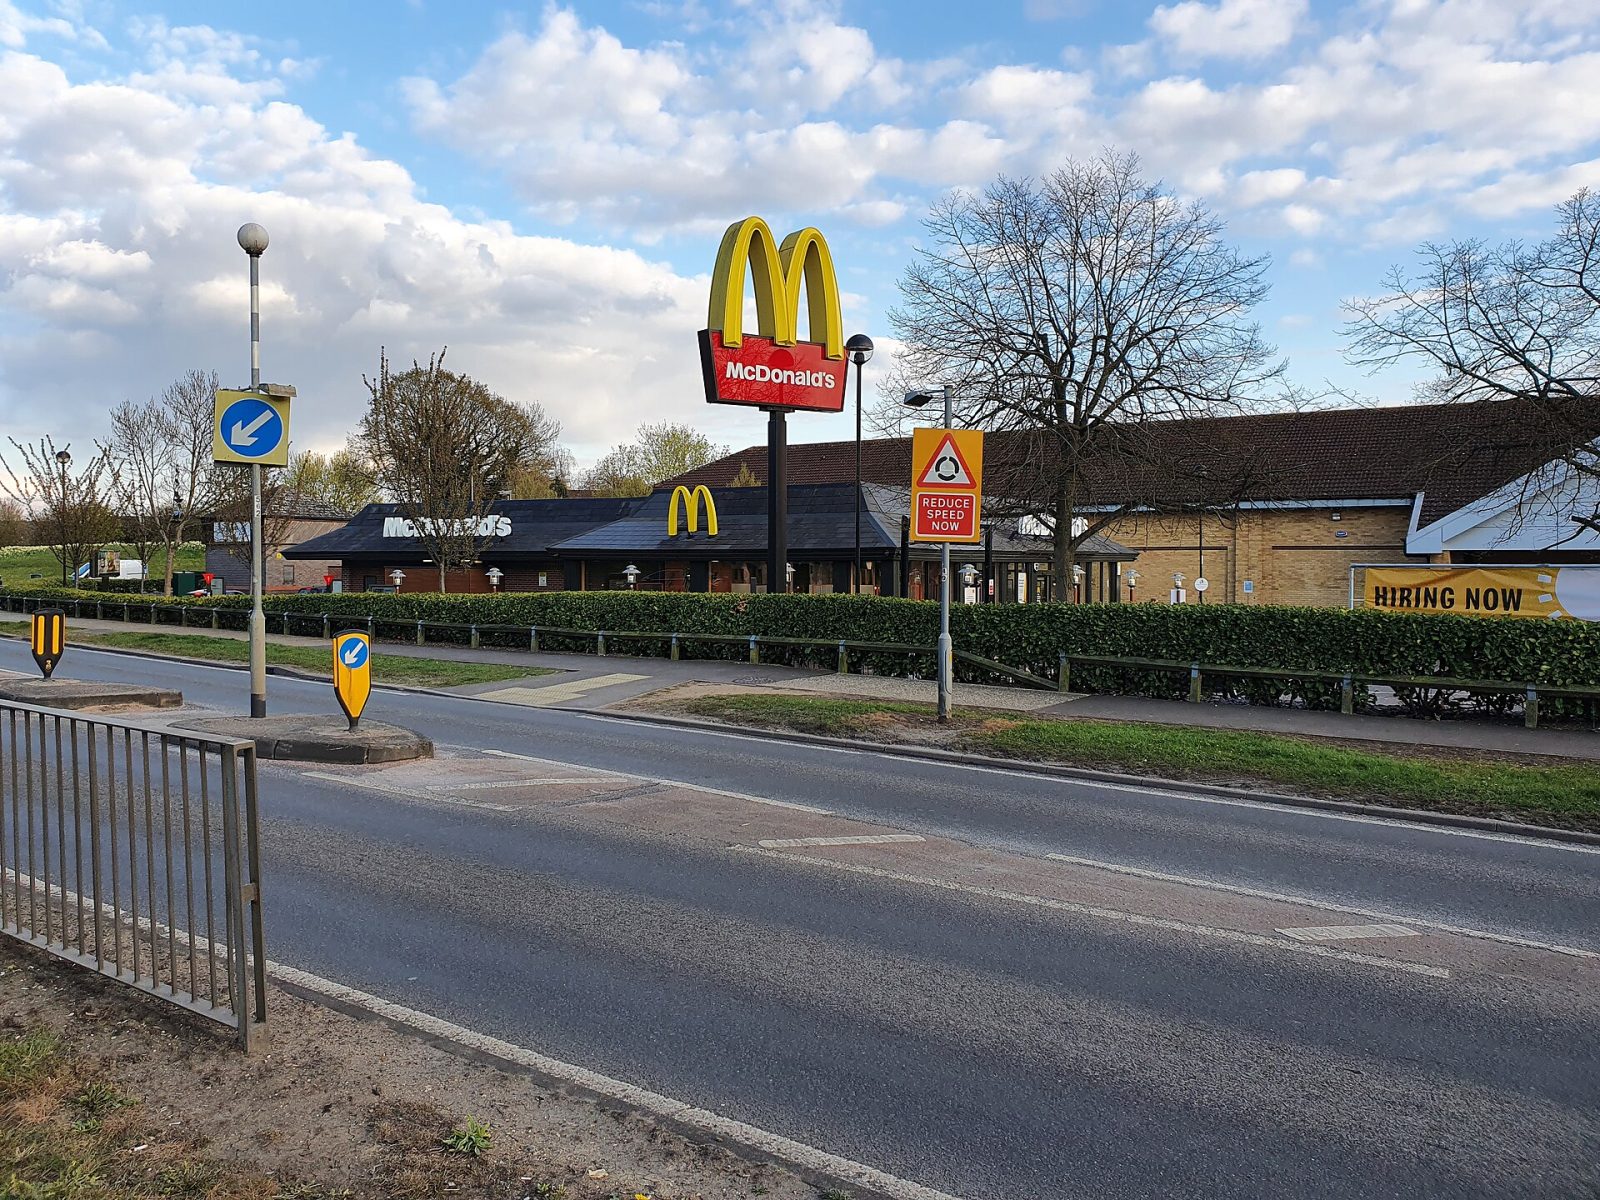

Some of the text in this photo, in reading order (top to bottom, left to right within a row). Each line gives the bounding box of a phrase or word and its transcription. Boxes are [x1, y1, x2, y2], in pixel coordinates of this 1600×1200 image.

[726, 361, 836, 389] McDonald's
[922, 498, 970, 508] REDUCE
[927, 510, 965, 519] SPEED
[931, 521, 960, 531] NOW
[1374, 586, 1523, 611] HIRING NOW
